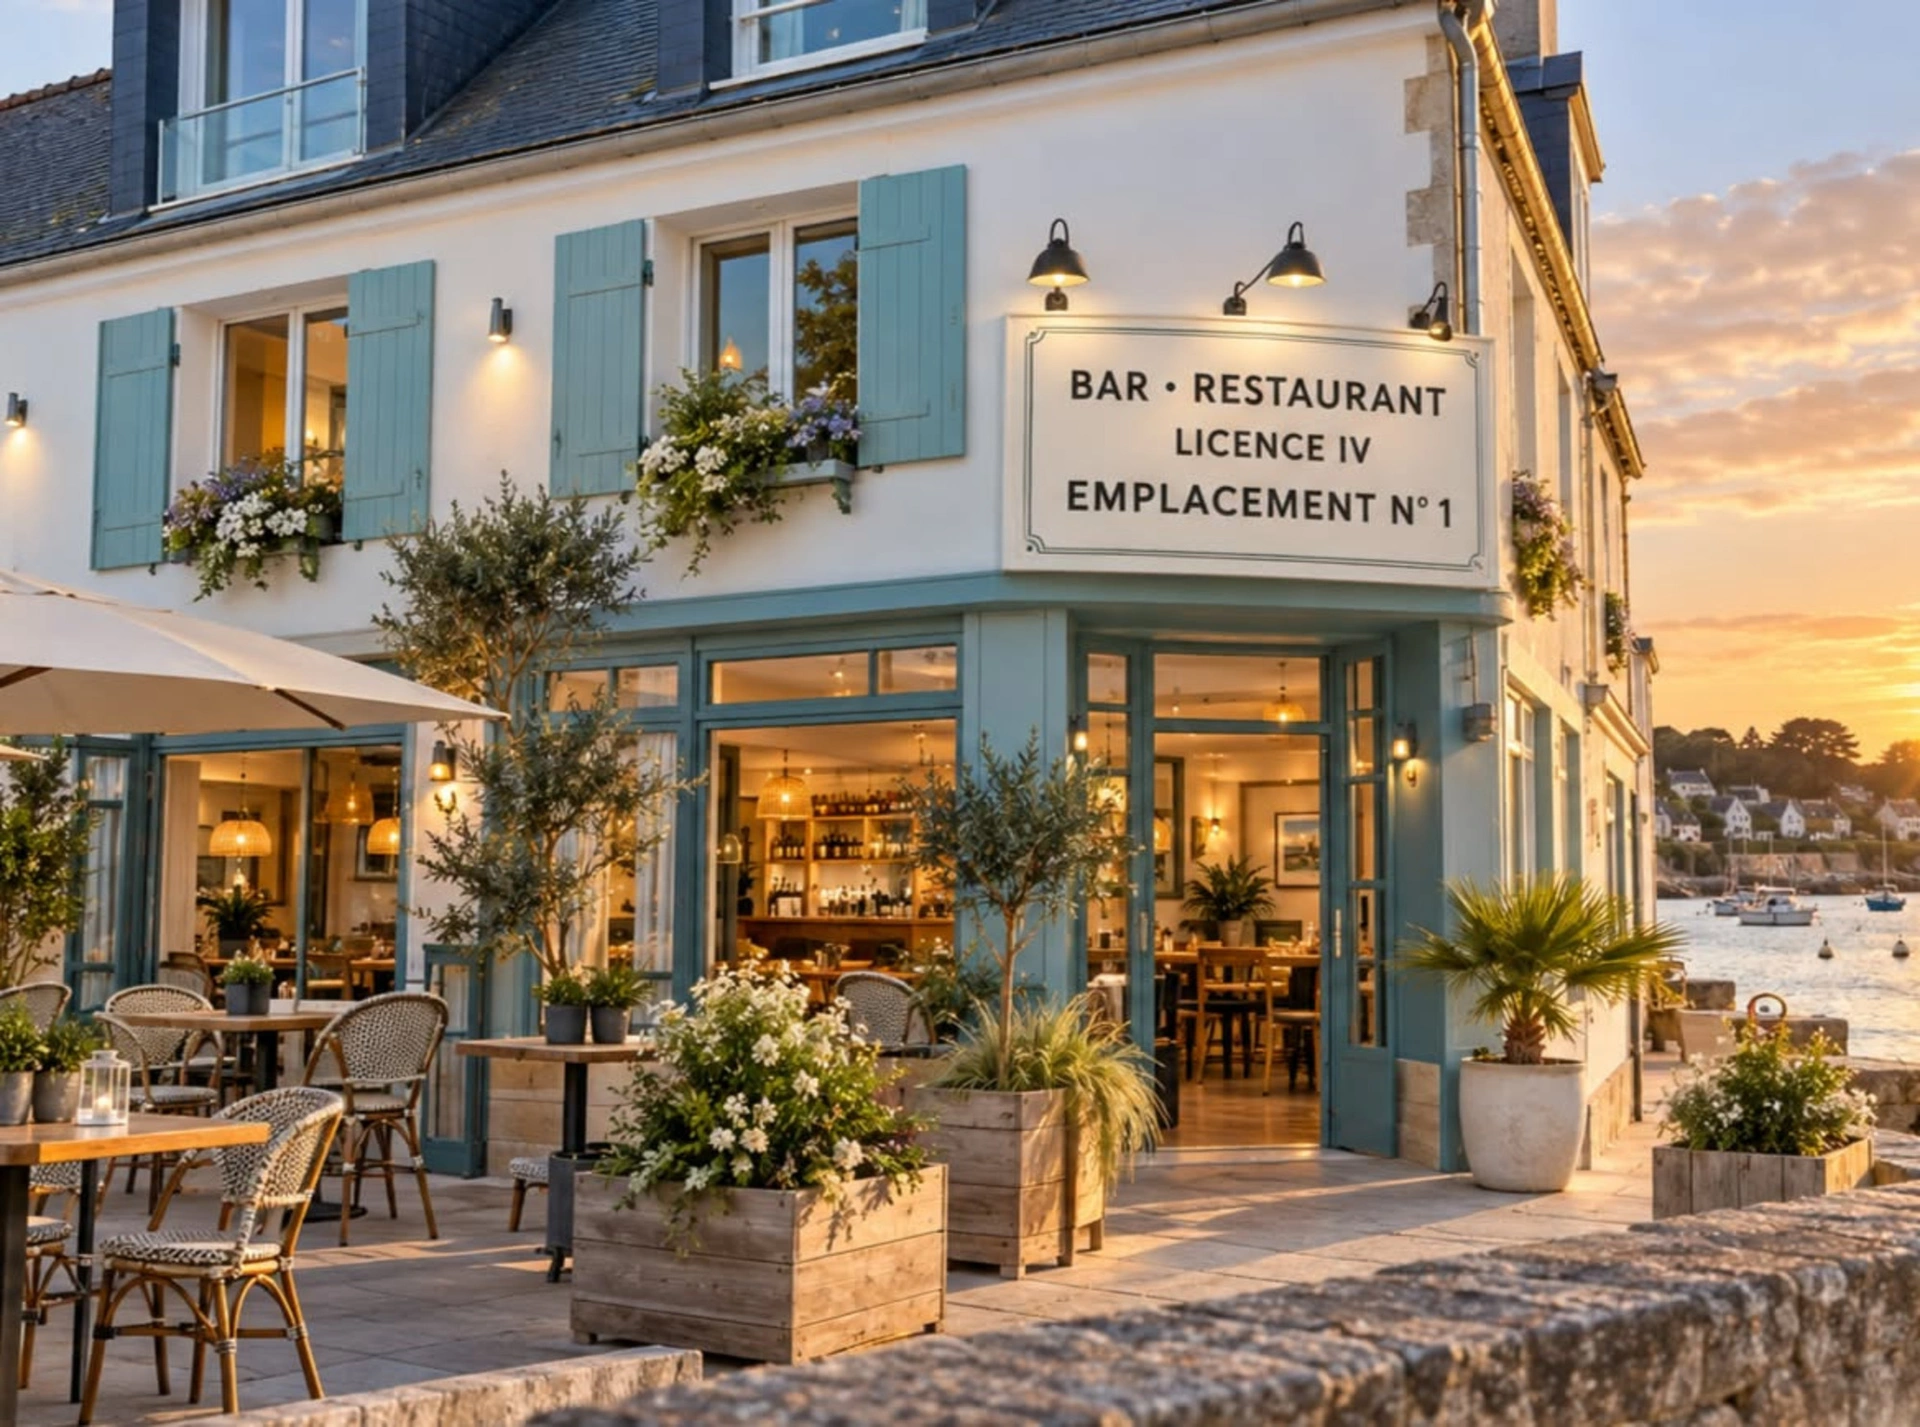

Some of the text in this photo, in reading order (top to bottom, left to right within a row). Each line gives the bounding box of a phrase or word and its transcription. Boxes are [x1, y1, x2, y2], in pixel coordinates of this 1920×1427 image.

[1070, 369, 1447, 418] BAR RESTAURANT
[1176, 427, 1371, 464] LICENCE IV
[1067, 479, 1377, 524] EMPLACEMENT
